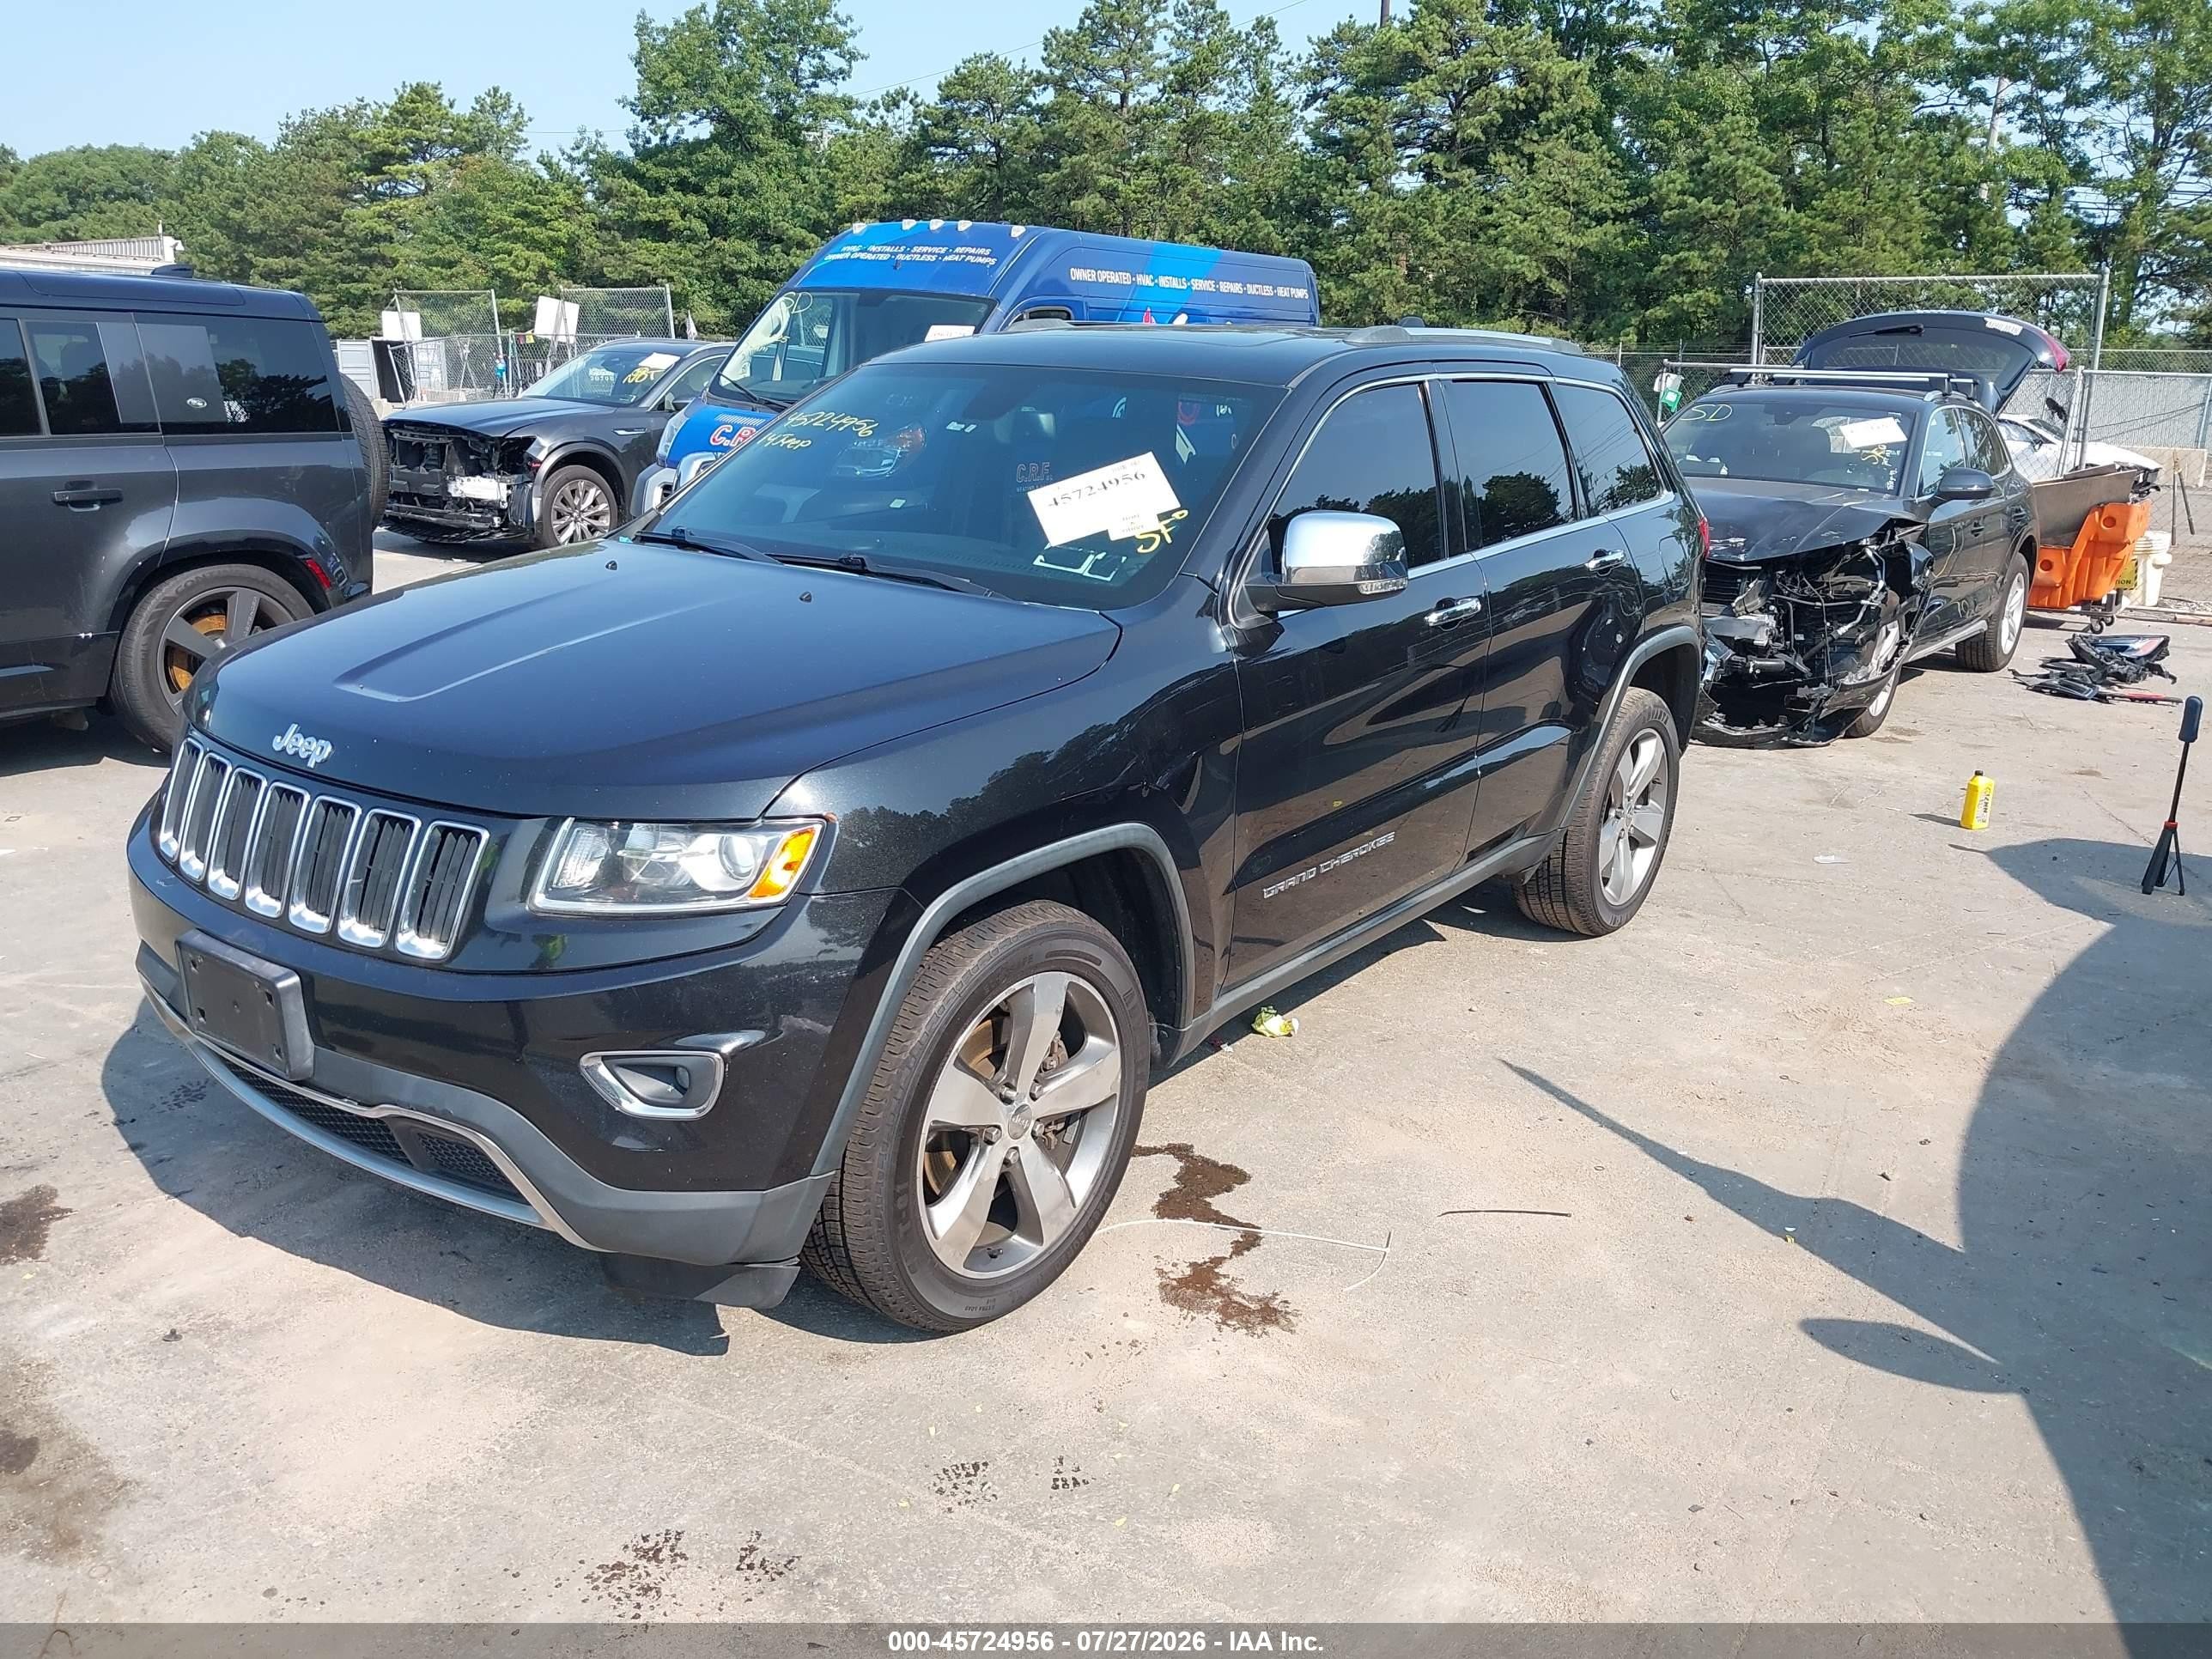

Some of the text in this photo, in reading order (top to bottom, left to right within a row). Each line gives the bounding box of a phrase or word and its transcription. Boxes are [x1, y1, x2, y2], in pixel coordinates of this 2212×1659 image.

[850, 252, 890, 261] OPERATED
[964, 256, 997, 265] PUMPS
[953, 246, 992, 255] REPAIRS
[1070, 268, 1309, 300] OWNER OPERATED HVAC INSTALLS SERVICE REPAIRS DUCTLESS HEAT PUMPS
[1048, 471, 1146, 507] 45724956
[272, 723, 332, 769] Jeep
[1263, 831, 1395, 898] GRAND CHEROKEE
